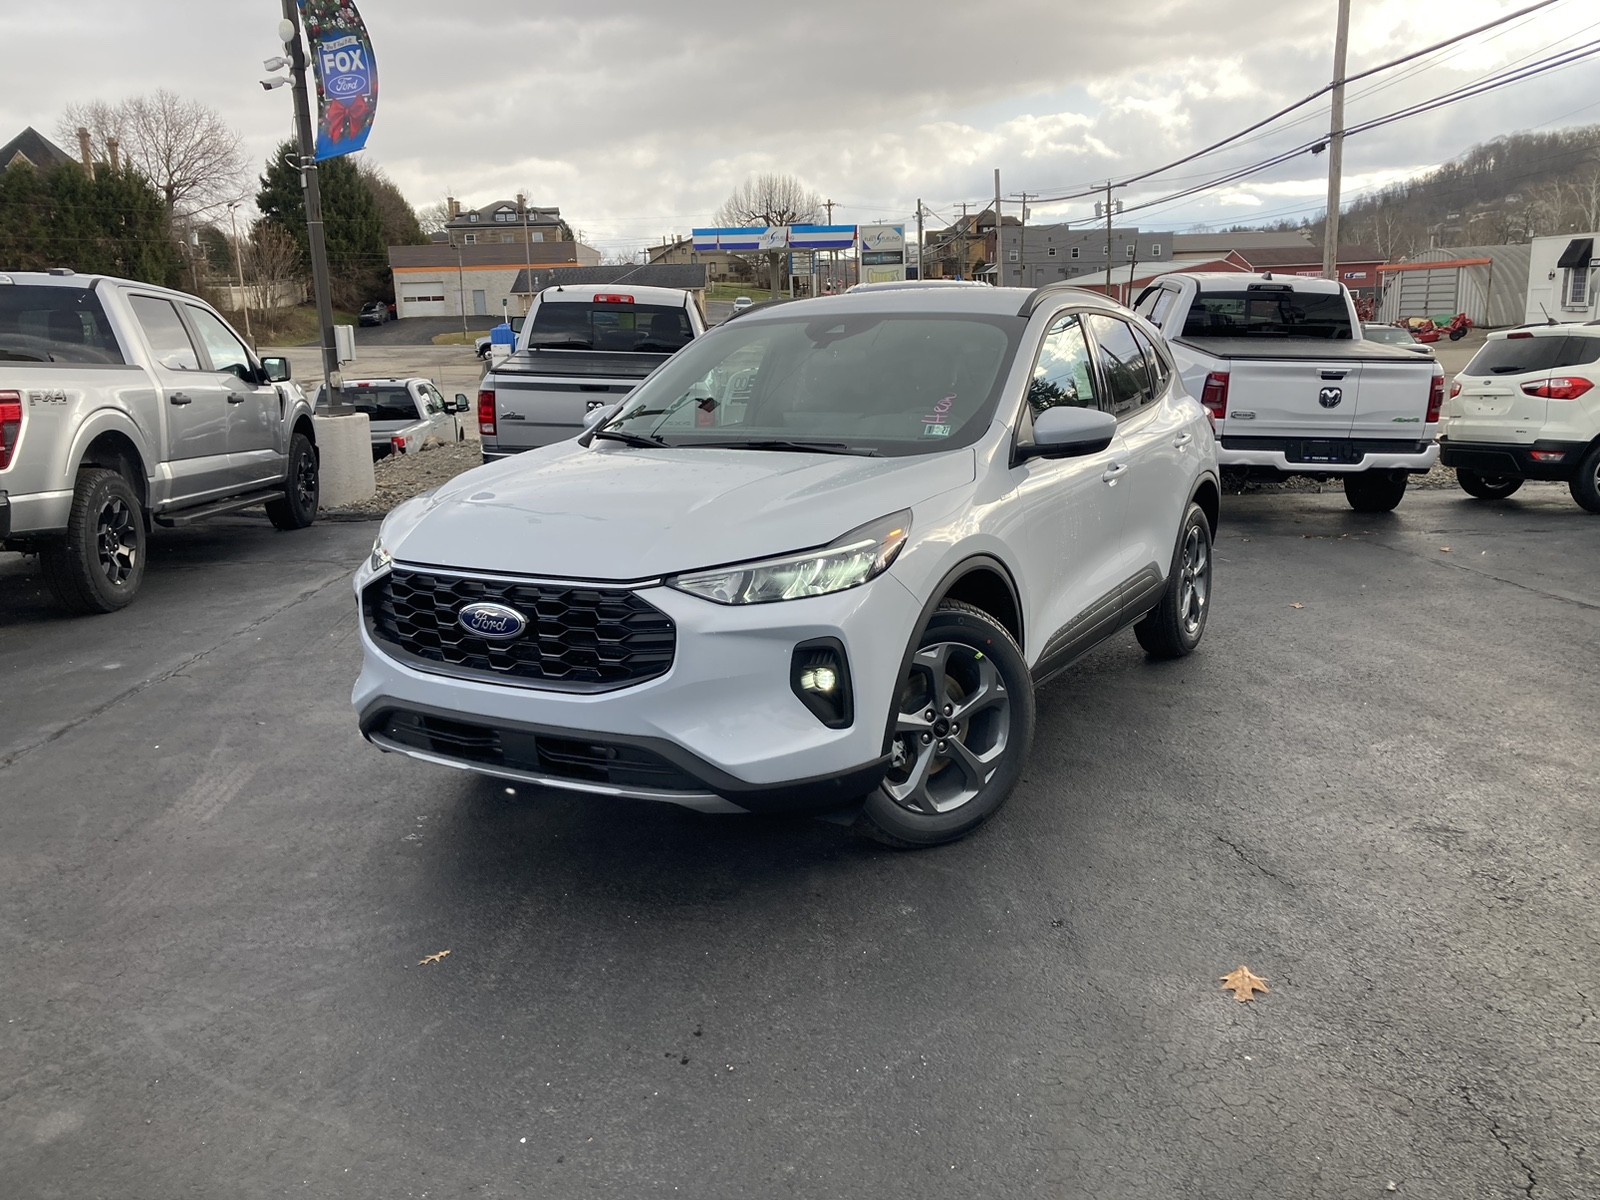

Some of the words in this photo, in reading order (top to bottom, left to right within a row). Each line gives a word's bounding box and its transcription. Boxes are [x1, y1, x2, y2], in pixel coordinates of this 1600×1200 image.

[322, 49, 366, 74] FOX
[335, 77, 358, 91] Ford
[29, 391, 67, 406] FX4
[471, 610, 507, 631] Ford
